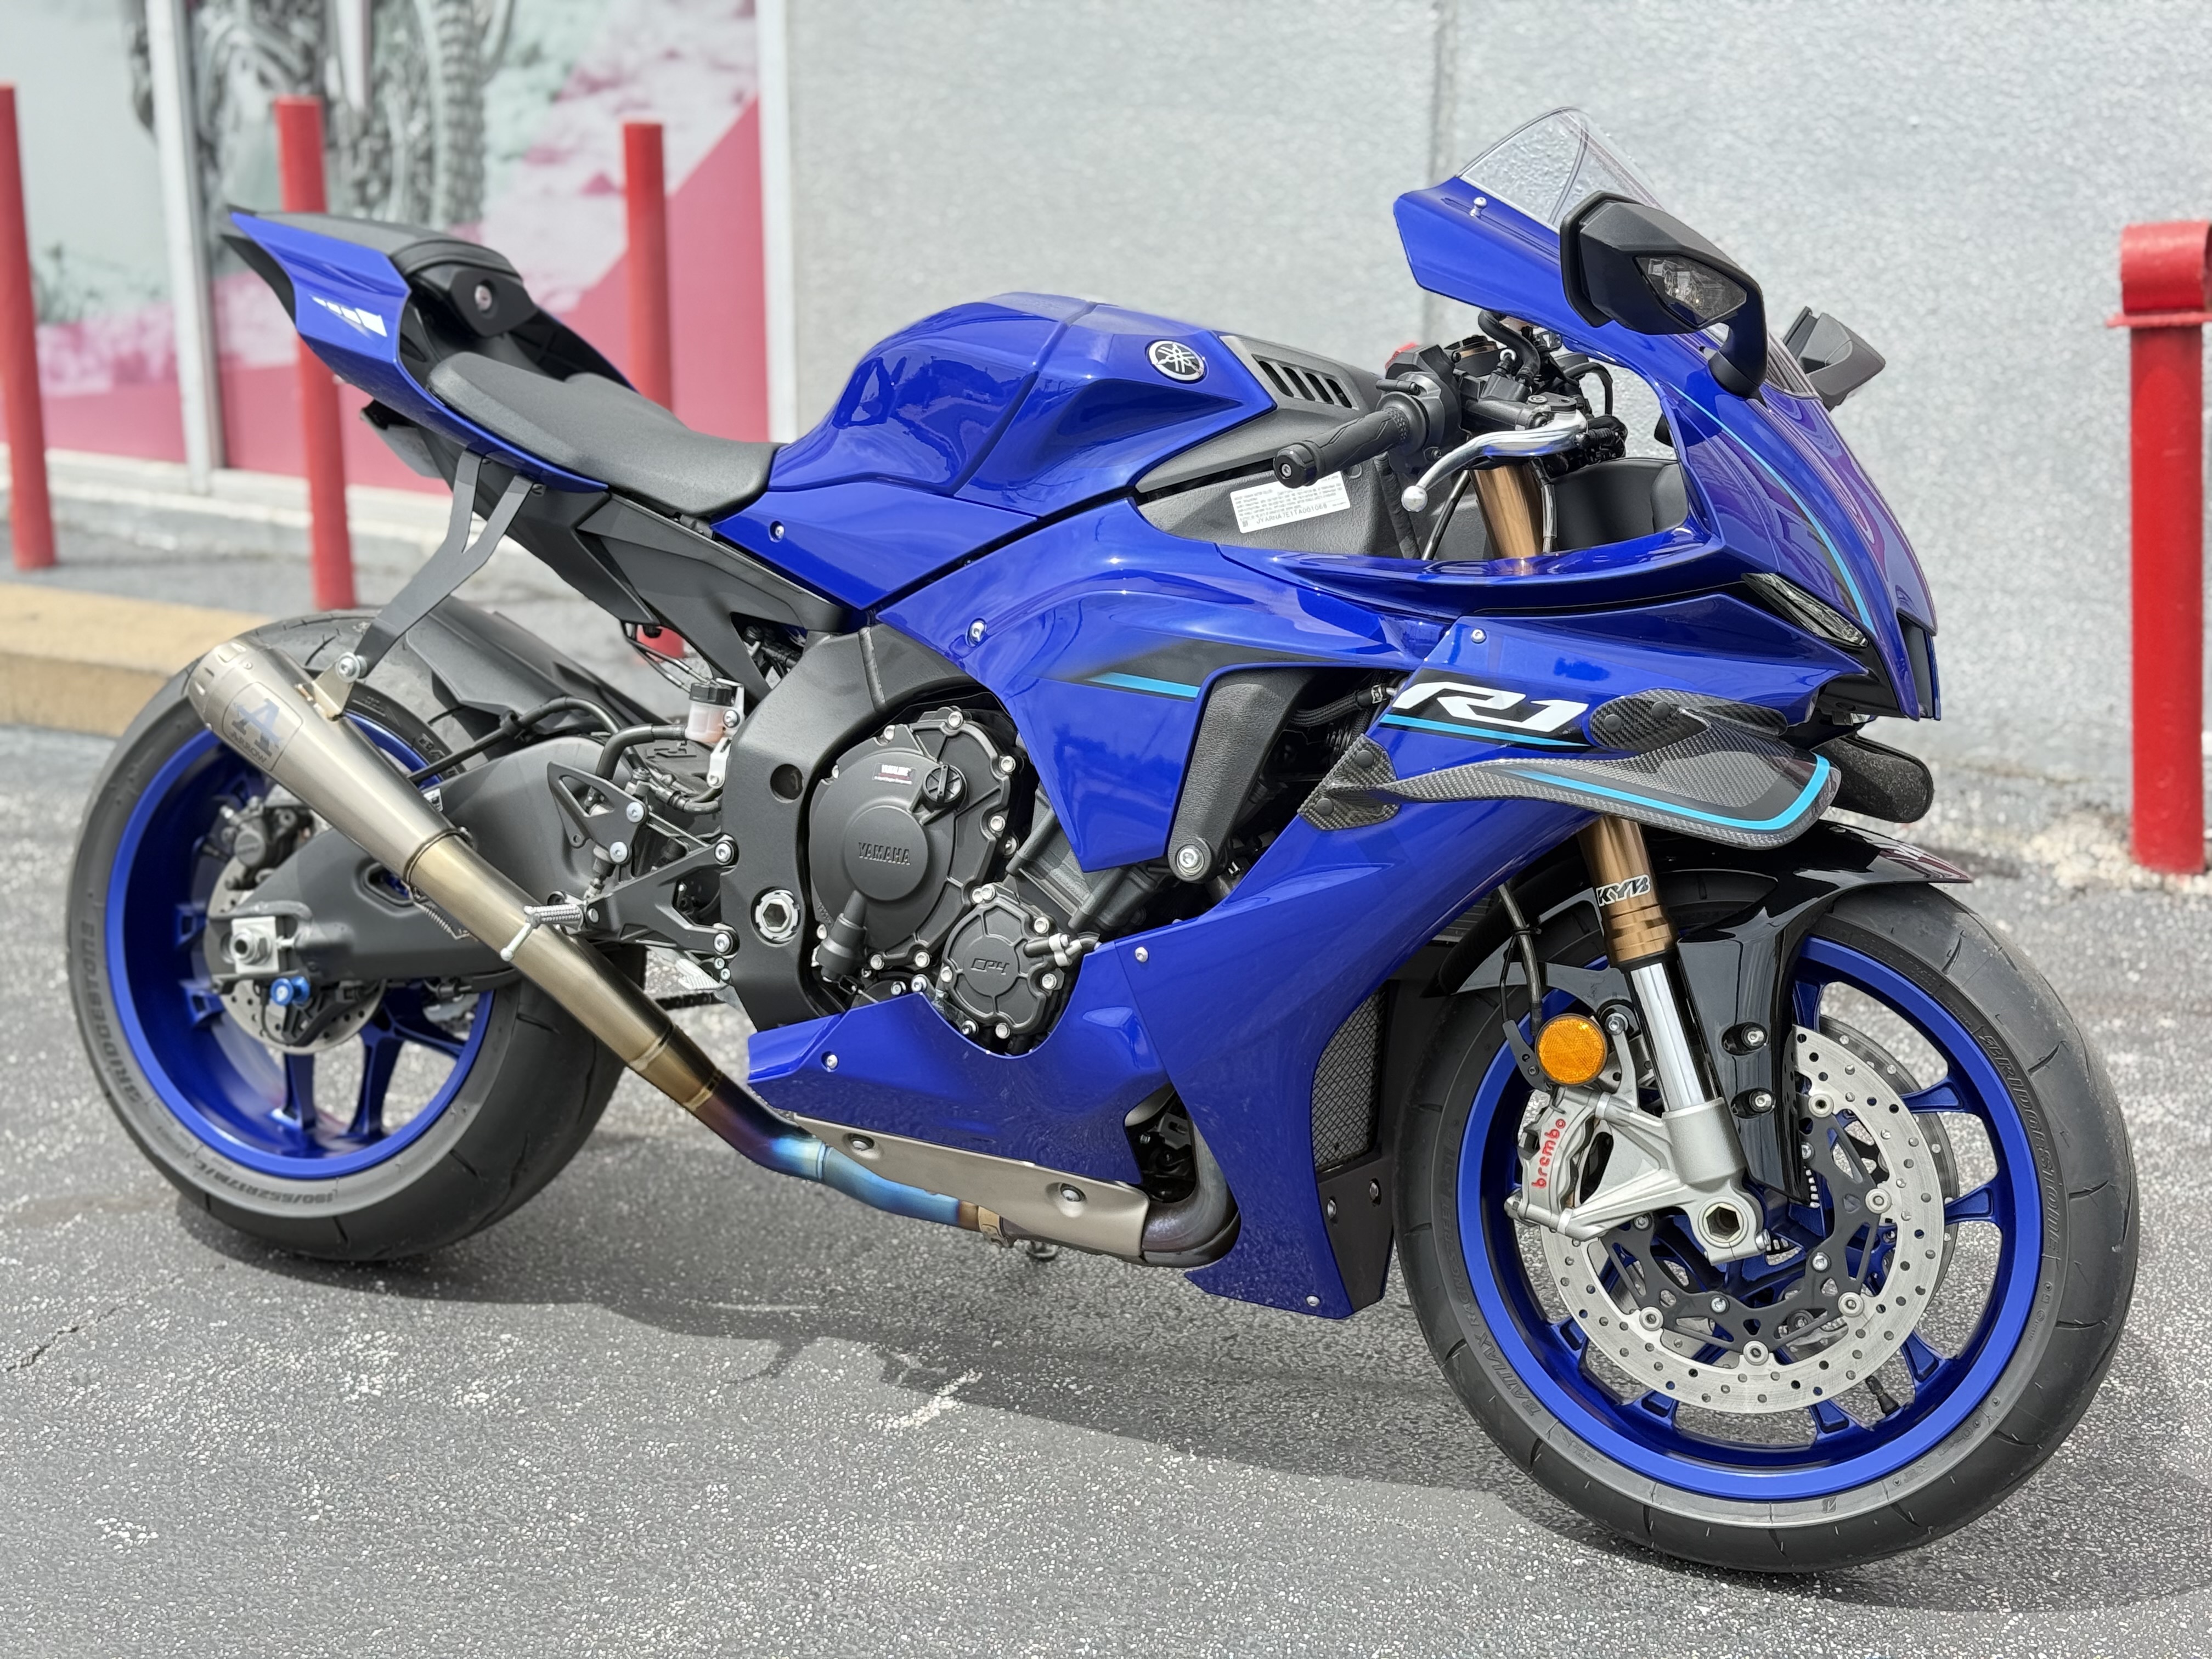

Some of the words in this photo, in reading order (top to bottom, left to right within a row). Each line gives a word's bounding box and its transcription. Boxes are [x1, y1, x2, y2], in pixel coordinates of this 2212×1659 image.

[1393, 681, 1589, 732] R1
[230, 732, 268, 764] ARROW
[859, 842, 911, 866] YAMAHA
[1595, 874, 1651, 907] KYB
[81, 919, 142, 1103] BRIDGESTONE
[1531, 1118, 1566, 1189] brembo
[1978, 1035, 2061, 1254] BRIDGESTONE
[1451, 1265, 1480, 1327] RACING
[1474, 1331, 1541, 1417] BATTLAX
